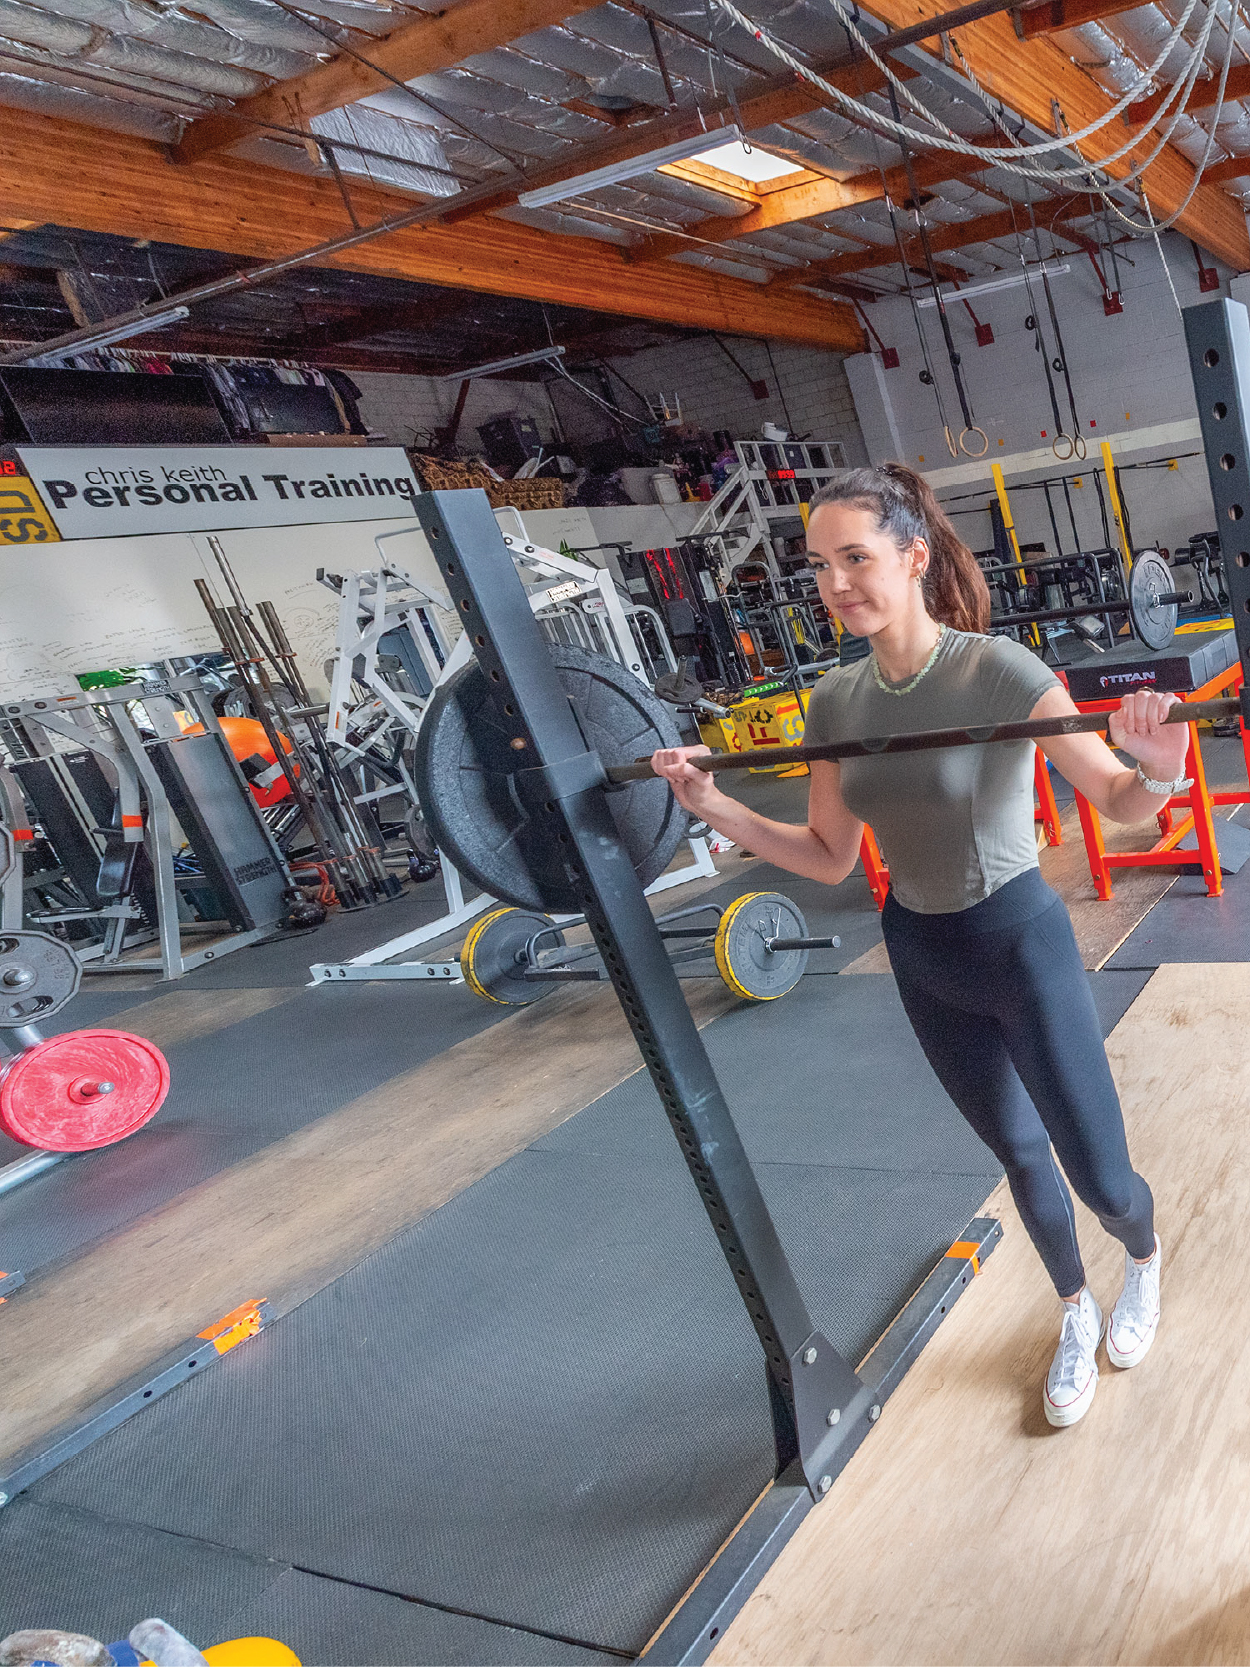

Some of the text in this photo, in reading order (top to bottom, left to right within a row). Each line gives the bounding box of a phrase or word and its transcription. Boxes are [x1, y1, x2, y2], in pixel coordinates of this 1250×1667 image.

[85, 465, 227, 484] chris keith
[43, 473, 416, 509] Personal Training
[1108, 671, 1156, 684] TITAN
